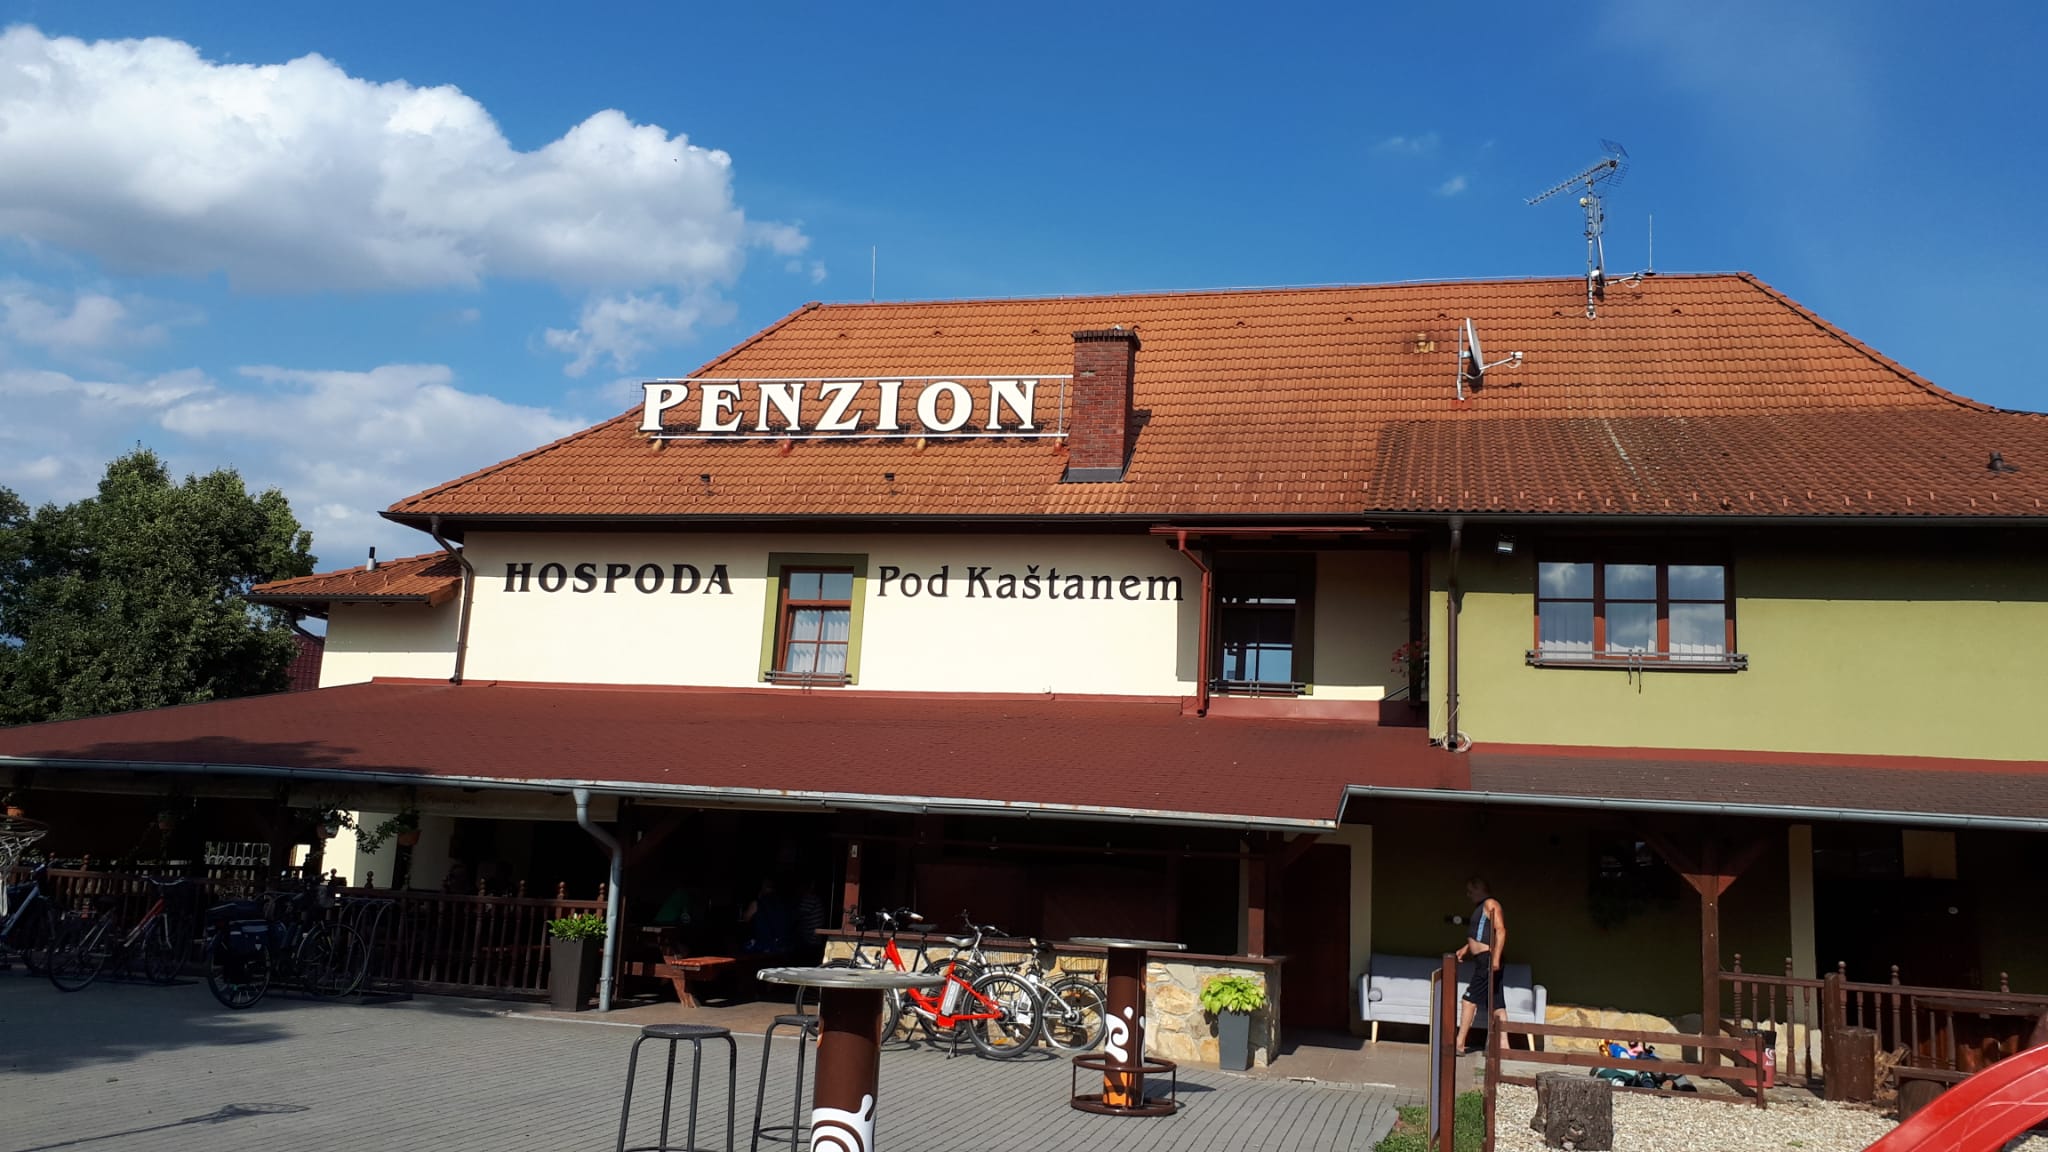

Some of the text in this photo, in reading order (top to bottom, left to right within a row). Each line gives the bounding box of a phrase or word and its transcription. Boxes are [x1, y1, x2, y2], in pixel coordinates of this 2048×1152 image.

[640, 381, 1038, 432] PENZION
[503, 562, 1183, 602] HOSPODA Pod Kaštanem
